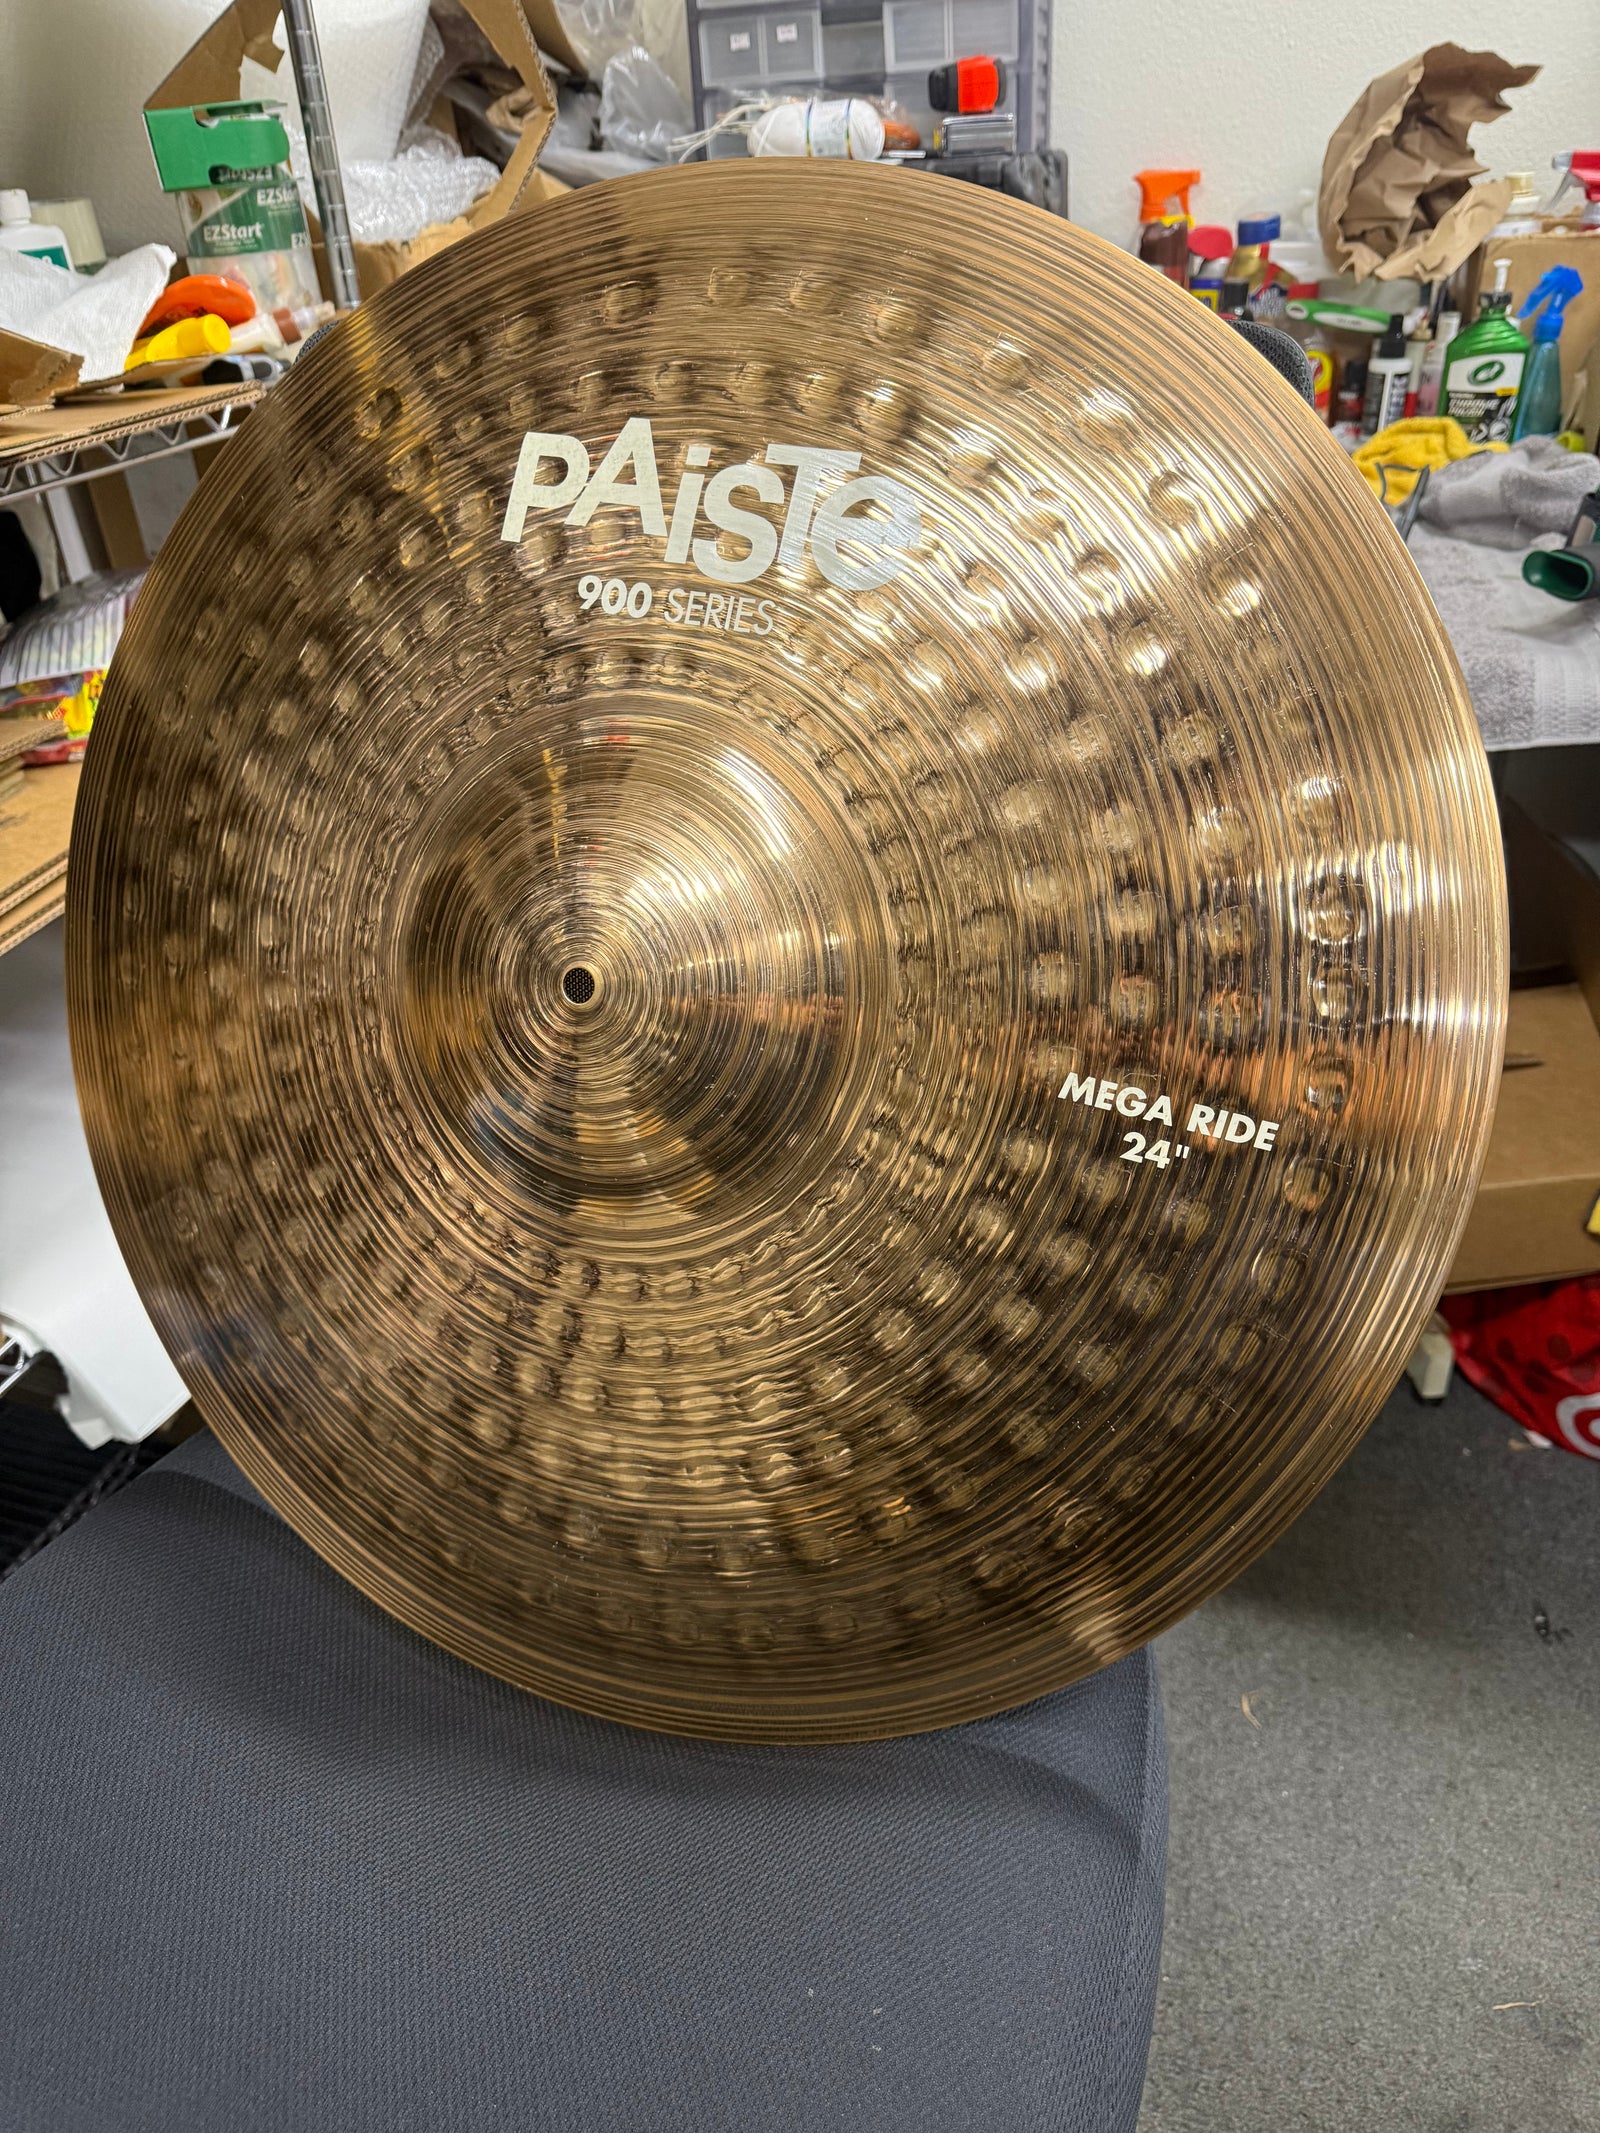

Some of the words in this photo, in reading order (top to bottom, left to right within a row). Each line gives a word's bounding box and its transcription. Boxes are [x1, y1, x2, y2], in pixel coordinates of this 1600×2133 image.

[204, 222, 262, 242] EZStart
[577, 574, 652, 619] 900
[663, 587, 775, 636] SERIES
[1057, 1072, 1173, 1127] MEGA
[1186, 1103, 1280, 1152] RIDE
[1119, 1132, 1190, 1169] 24"
